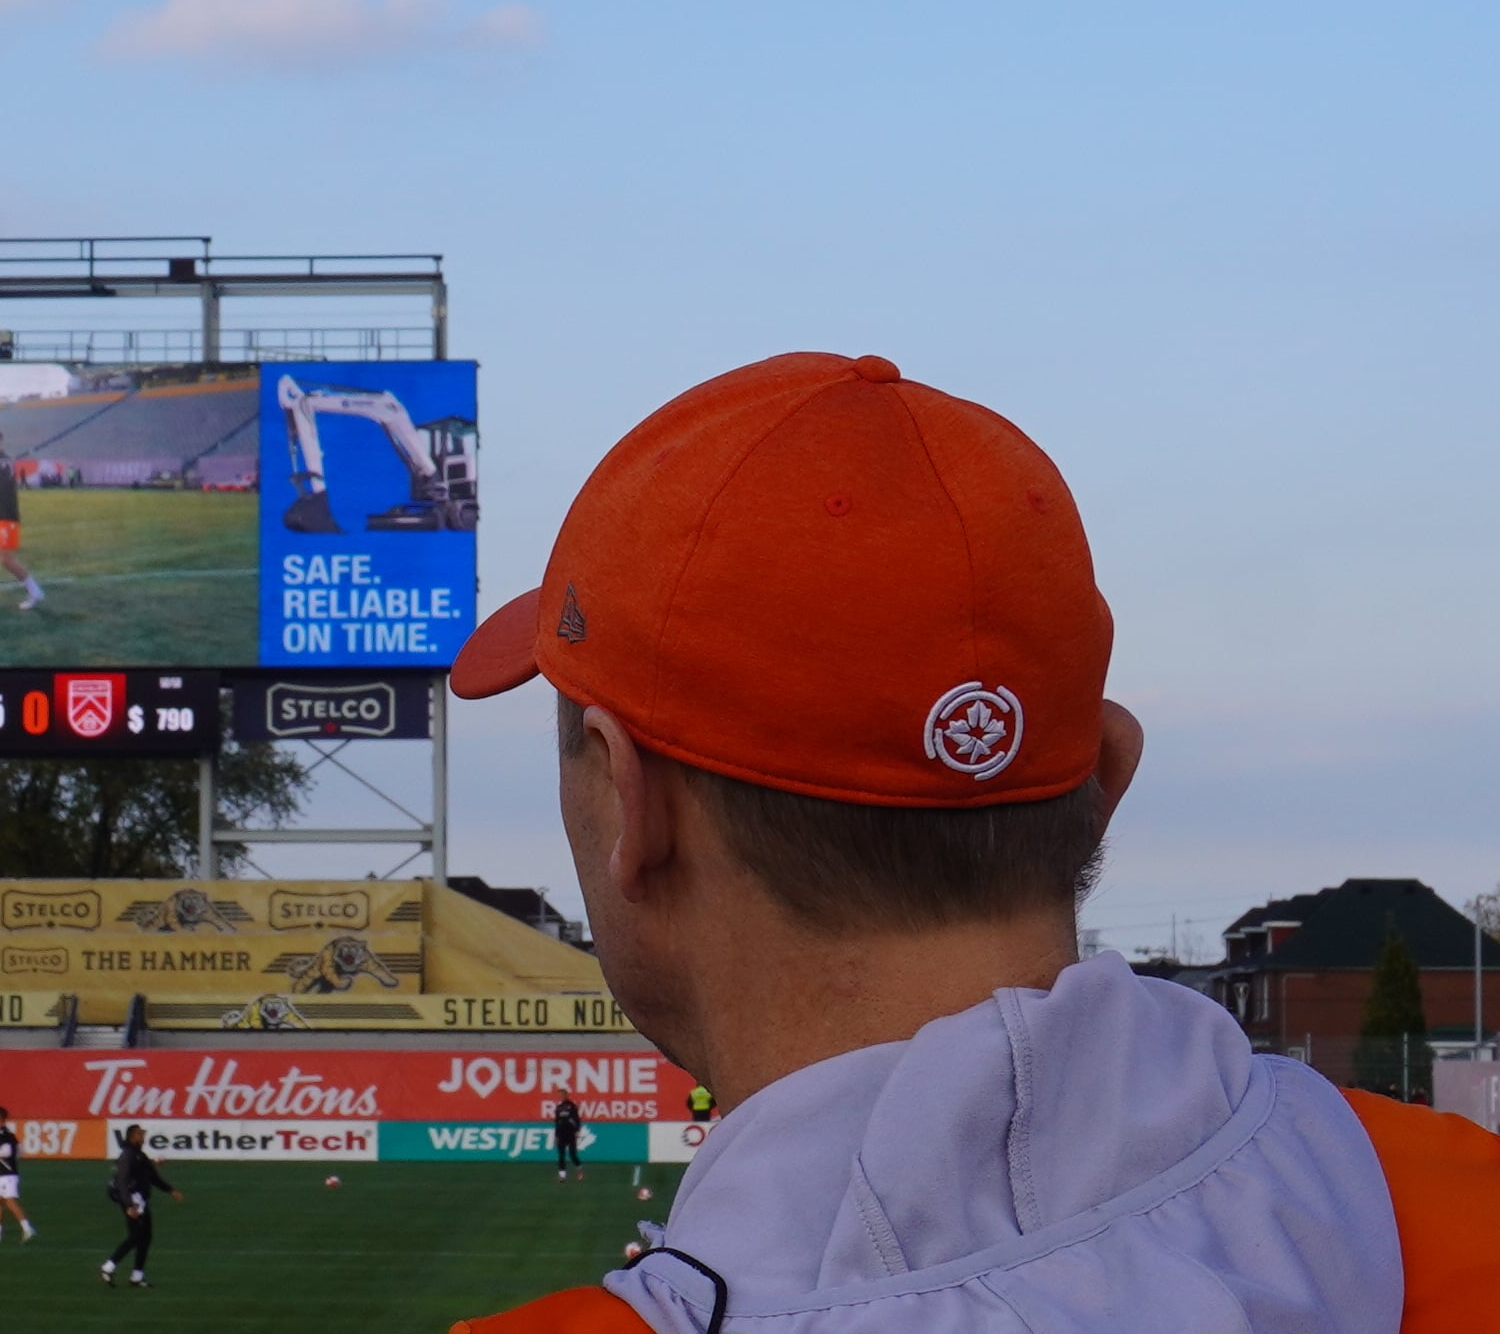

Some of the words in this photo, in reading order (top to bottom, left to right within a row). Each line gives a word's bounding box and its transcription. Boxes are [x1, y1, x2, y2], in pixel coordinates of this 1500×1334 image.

[282, 553, 381, 585] SAFE.
[282, 587, 461, 619] RELIABLE.
[282, 622, 331, 654] ON
[341, 622, 438, 654] TIME.
[22, 689, 49, 735] 0
[155, 707, 194, 732] 790
[281, 697, 381, 720] STELCO
[11, 900, 90, 919] STELCO
[280, 901, 359, 919] STELCO
[9, 953, 62, 966] STELCO
[81, 950, 132, 970] THE
[141, 951, 251, 971] HAMMER
[443, 998, 548, 1026] STELCO
[573, 999, 627, 1027] NOR
[84, 1059, 176, 1116] Tim
[184, 1056, 378, 1116] Hortons
[438, 1057, 658, 1099] JOURNIE
[541, 1100, 658, 1119] RWARDS
[23, 1120, 79, 1155] 837
[428, 1127, 556, 1158] WESTJET
